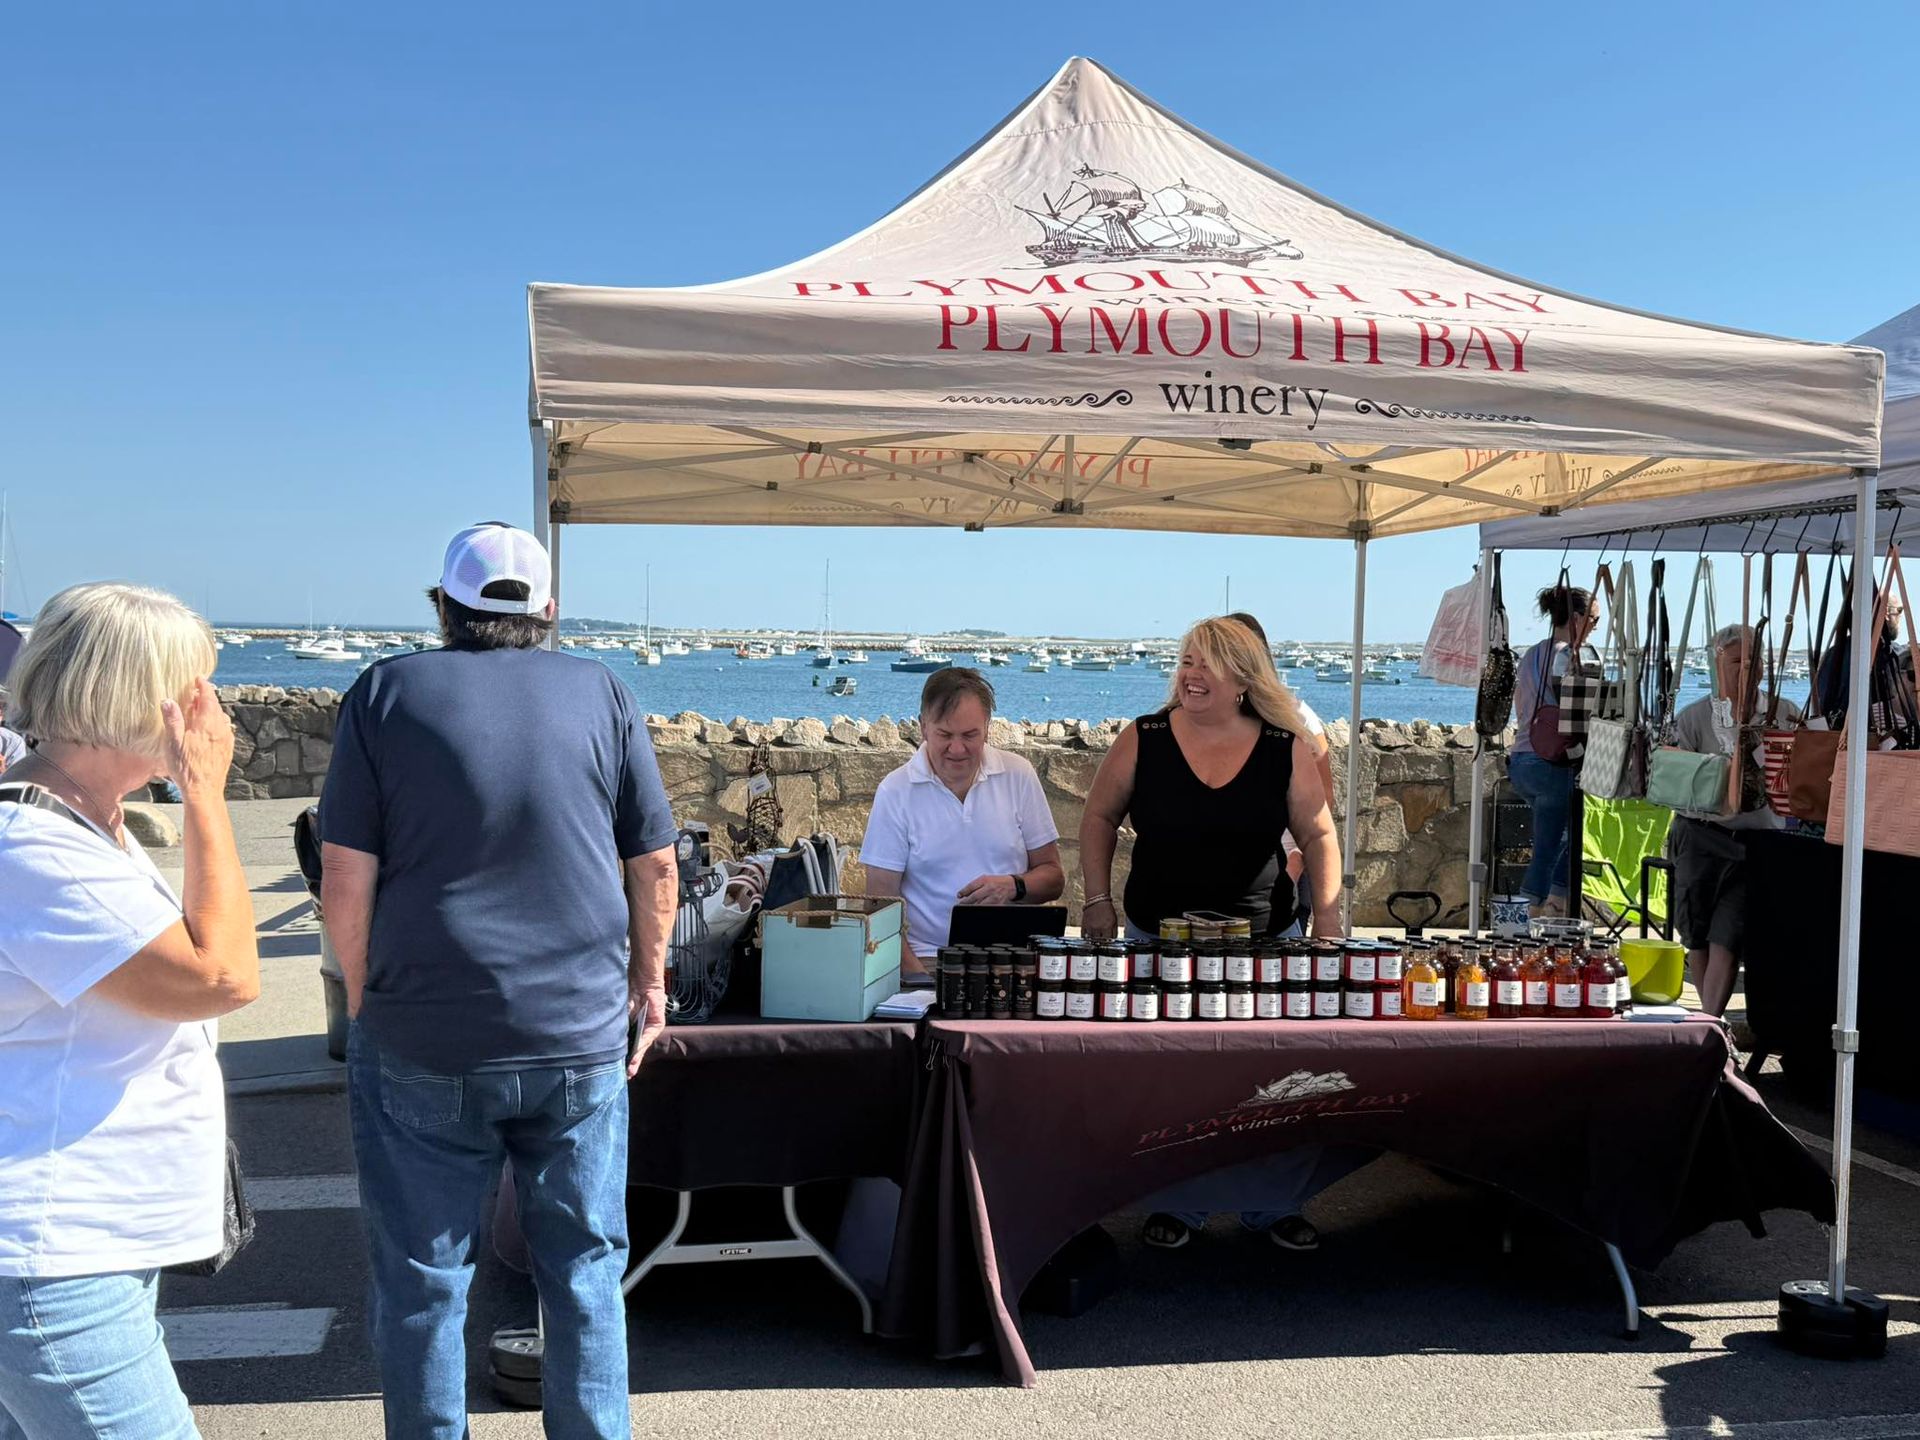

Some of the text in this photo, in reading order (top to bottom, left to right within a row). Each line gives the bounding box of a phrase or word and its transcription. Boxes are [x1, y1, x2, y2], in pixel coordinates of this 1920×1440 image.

[788, 270, 1552, 313] PLYMOUTH BAY
[936, 303, 1532, 372] PLYMOUTH BAY
[1158, 370, 1329, 431] winery
[1138, 1099, 1349, 1145] PLYMOUTH
[1230, 1112, 1309, 1134] winery
